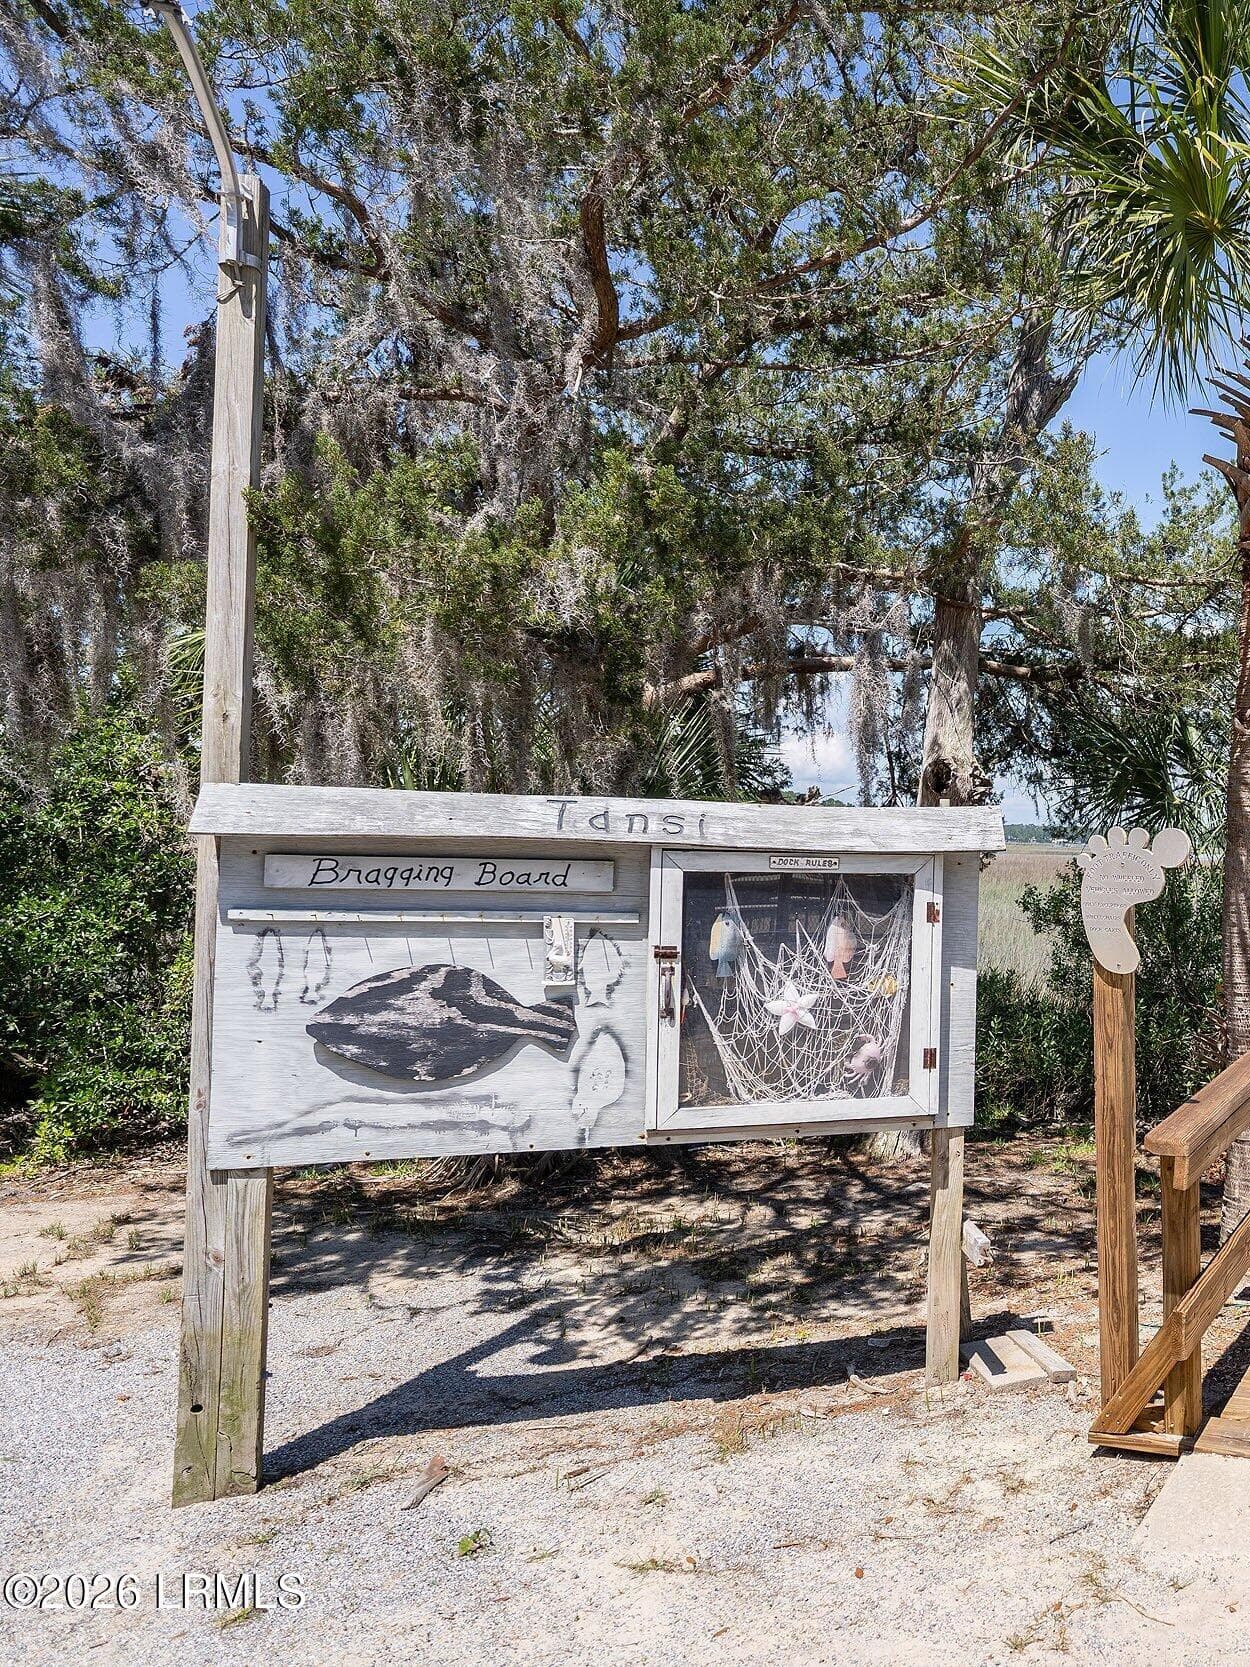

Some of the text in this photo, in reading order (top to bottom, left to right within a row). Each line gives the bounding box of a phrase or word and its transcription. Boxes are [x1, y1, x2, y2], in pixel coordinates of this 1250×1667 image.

[546, 799, 708, 838] Tansi
[308, 856, 573, 889] Bragging Board
[777, 858, 834, 868] DOCK RULES
[1086, 851, 1161, 879] FOOT TRAFFIC ONLY
[1123, 888, 1155, 896] ALLOWED
